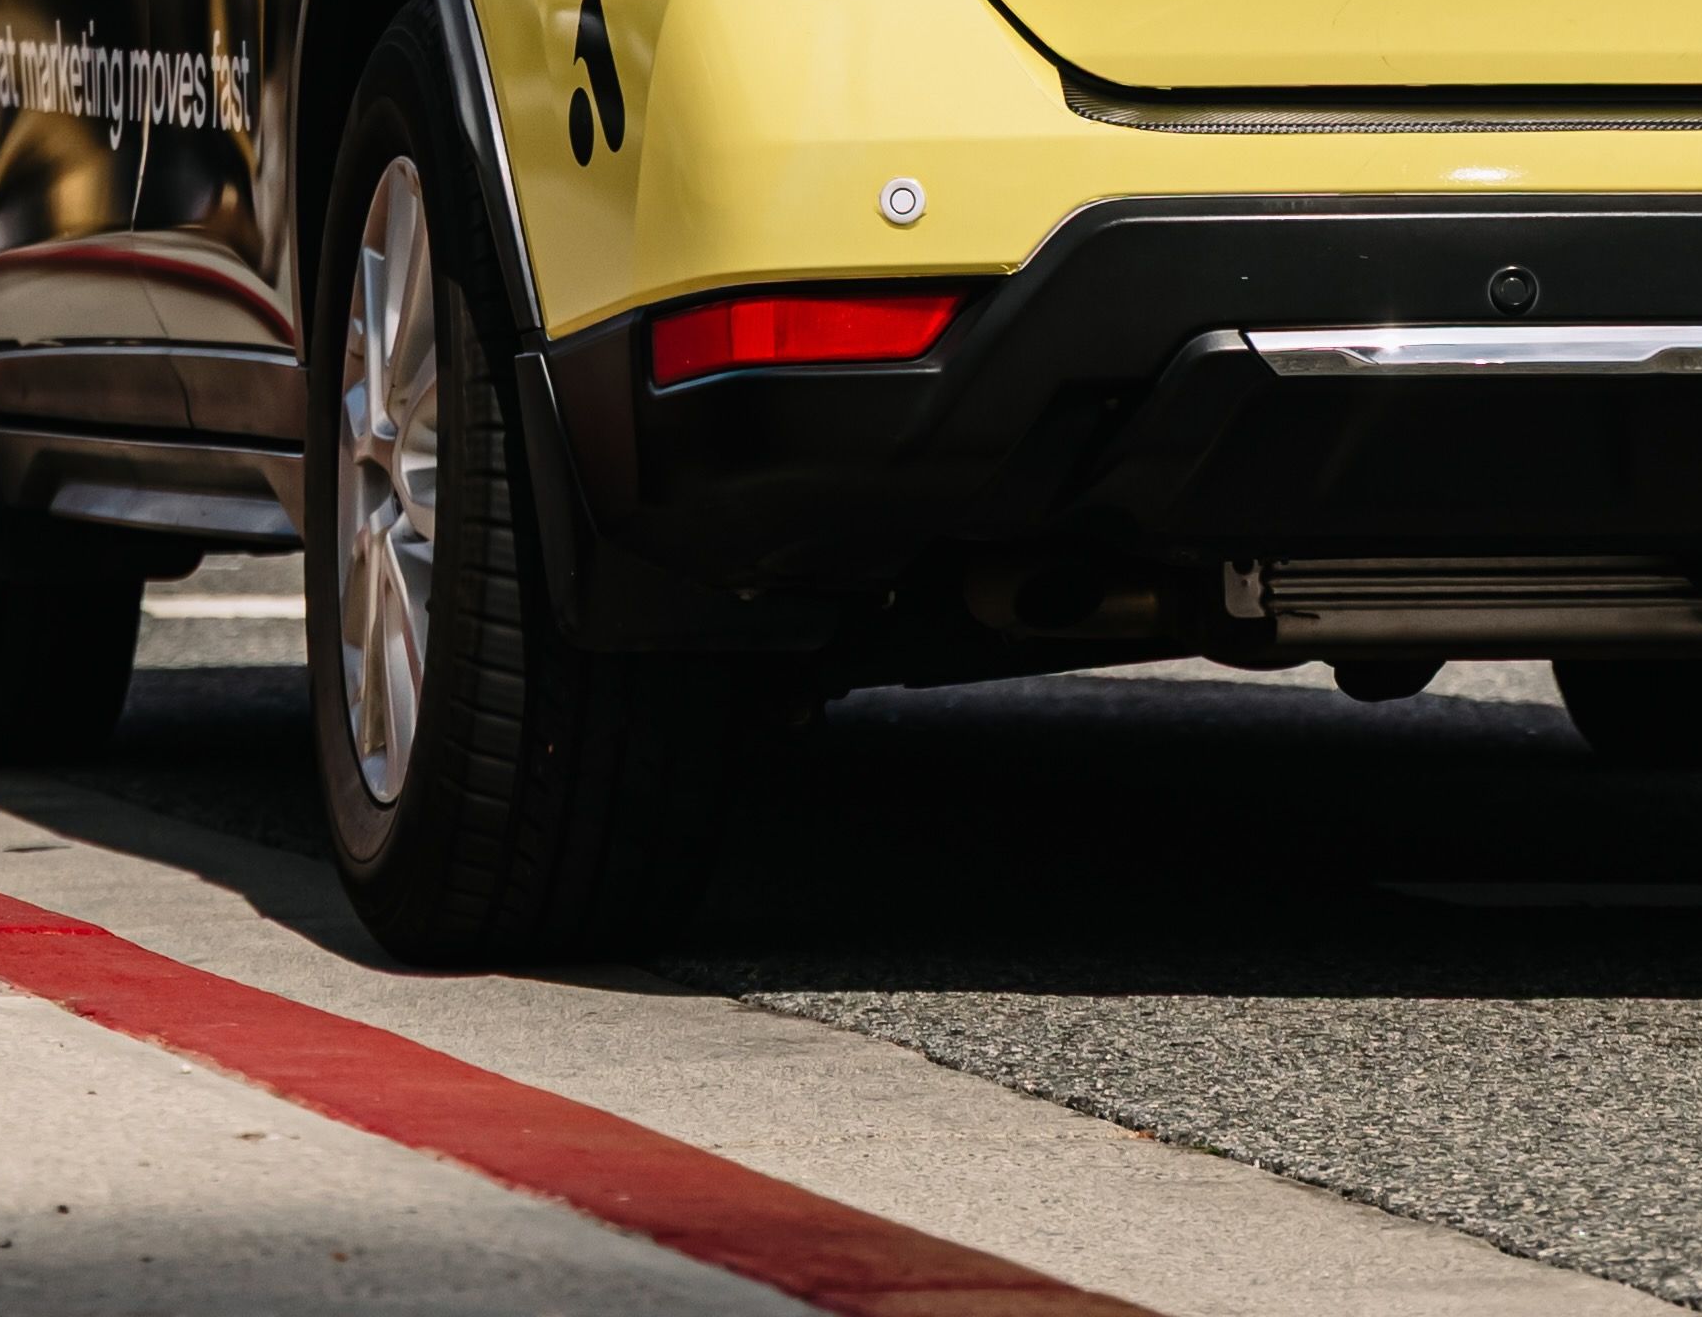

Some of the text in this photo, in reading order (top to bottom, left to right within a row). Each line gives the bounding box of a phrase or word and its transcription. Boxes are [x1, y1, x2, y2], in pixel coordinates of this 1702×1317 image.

[19, 18, 125, 151] marketing
[129, 49, 207, 131] moves
[210, 29, 251, 133] fast
